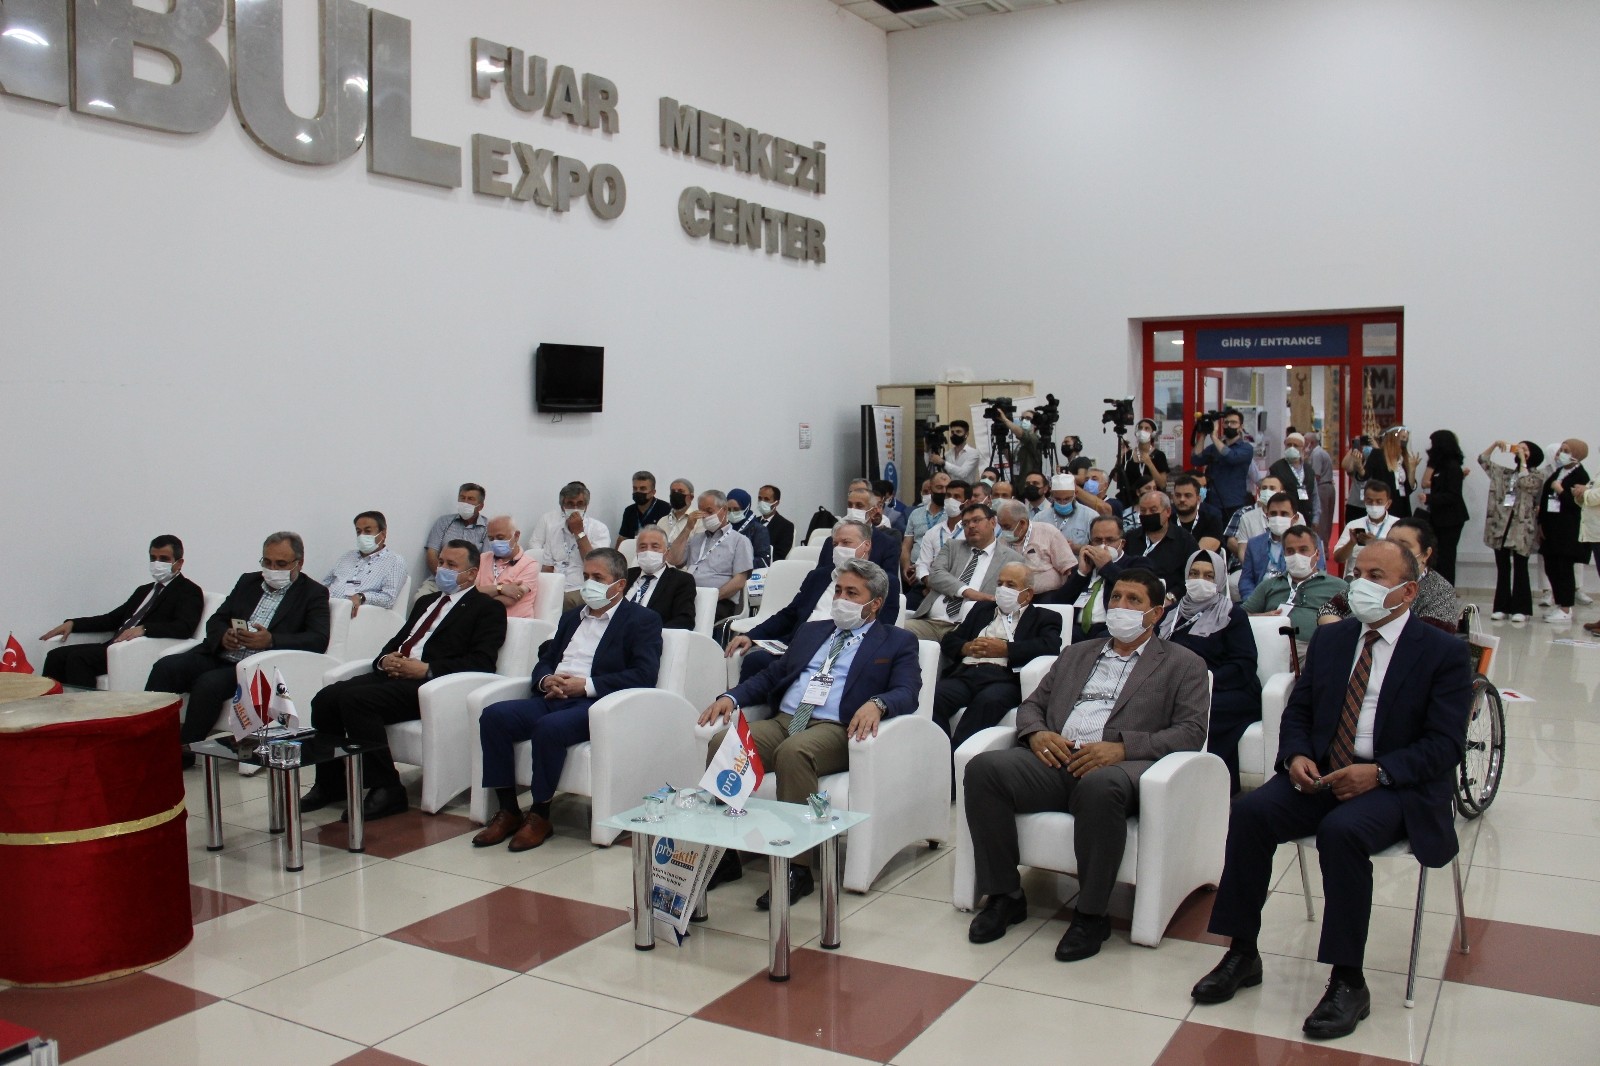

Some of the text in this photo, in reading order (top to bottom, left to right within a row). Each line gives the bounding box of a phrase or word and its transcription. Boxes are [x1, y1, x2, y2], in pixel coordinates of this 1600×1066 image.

[470, 36, 827, 195] FUAR MERKEZİ
[471, 132, 827, 264] EXPO CENTER
[1221, 337, 1252, 349] GİRİŞ
[1260, 335, 1322, 347] ENTRANCE
